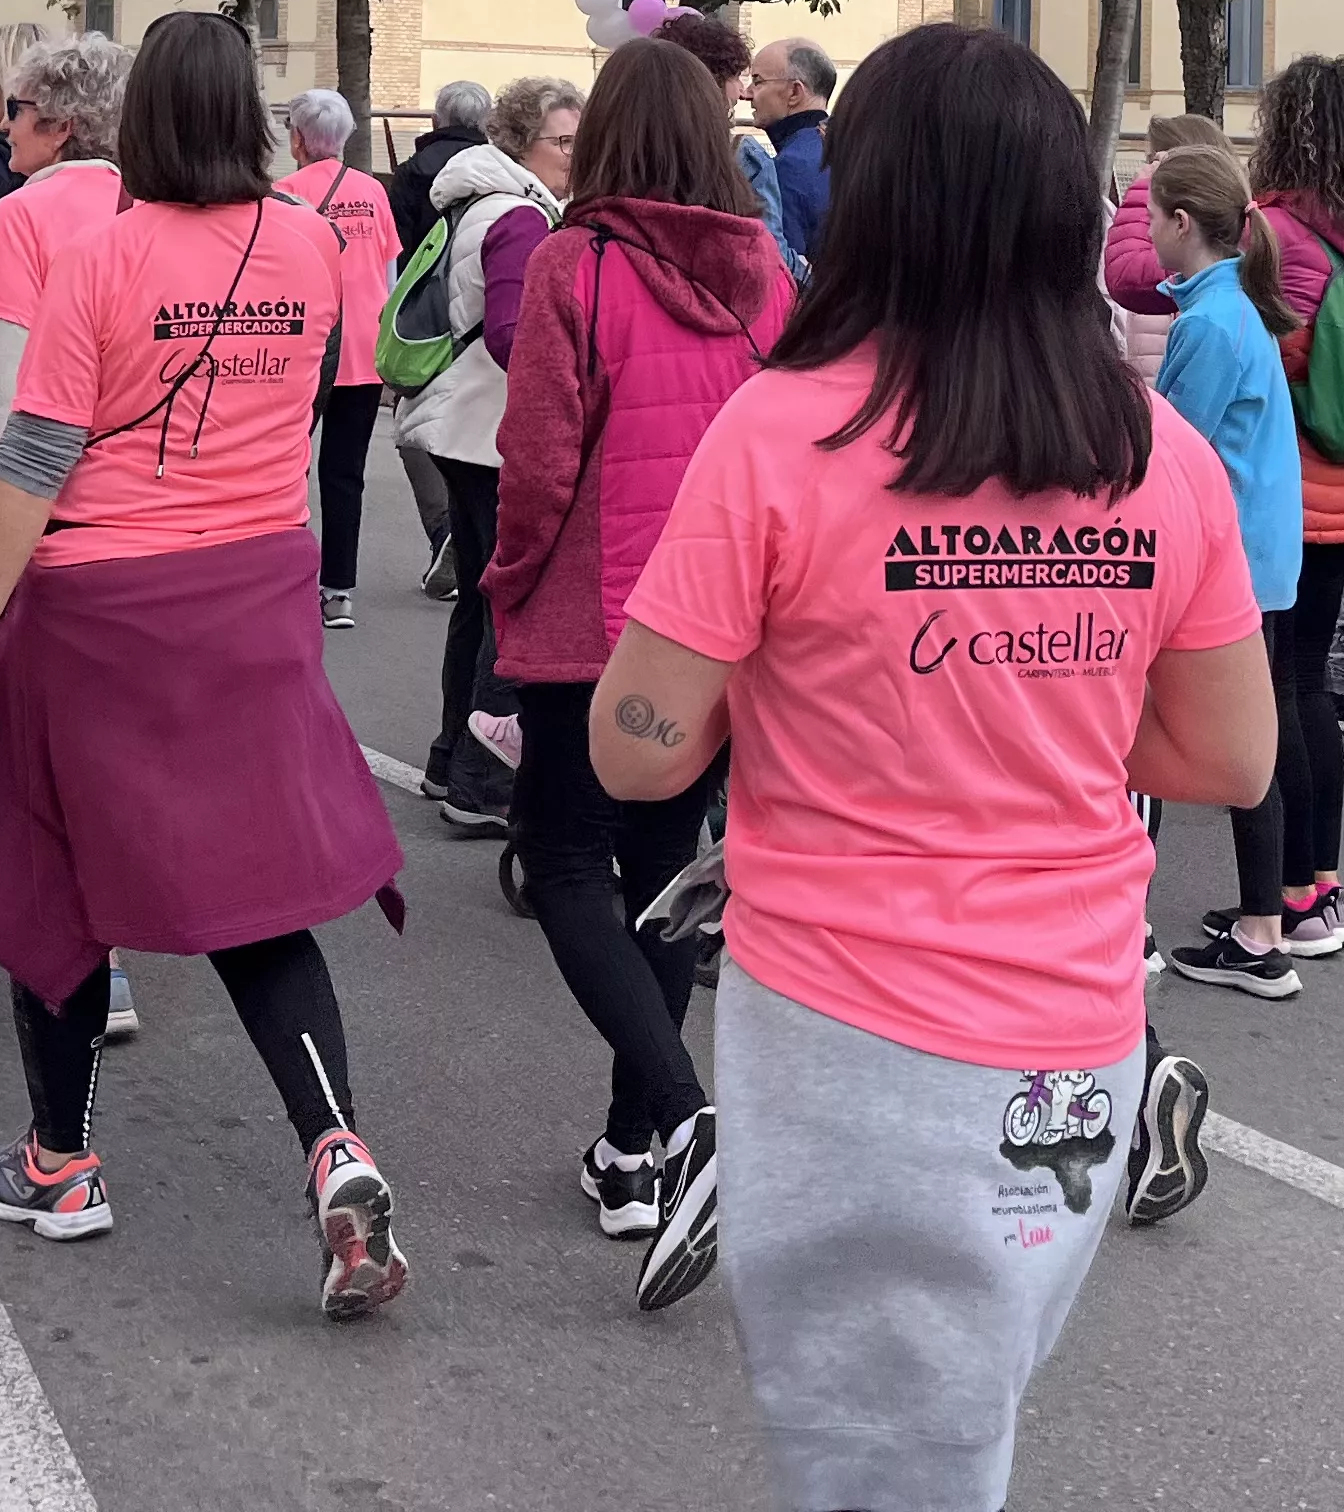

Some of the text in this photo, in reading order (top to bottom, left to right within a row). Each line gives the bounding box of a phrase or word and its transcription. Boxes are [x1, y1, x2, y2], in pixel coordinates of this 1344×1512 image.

[154, 295, 306, 322] ALTOARAGÓN
[169, 321, 292, 337] SUPERMERCADOS
[884, 516, 1157, 558] ALTOARAGÓN
[915, 563, 1131, 586] SUPERMERCADOS
[968, 612, 1129, 665] castellar
